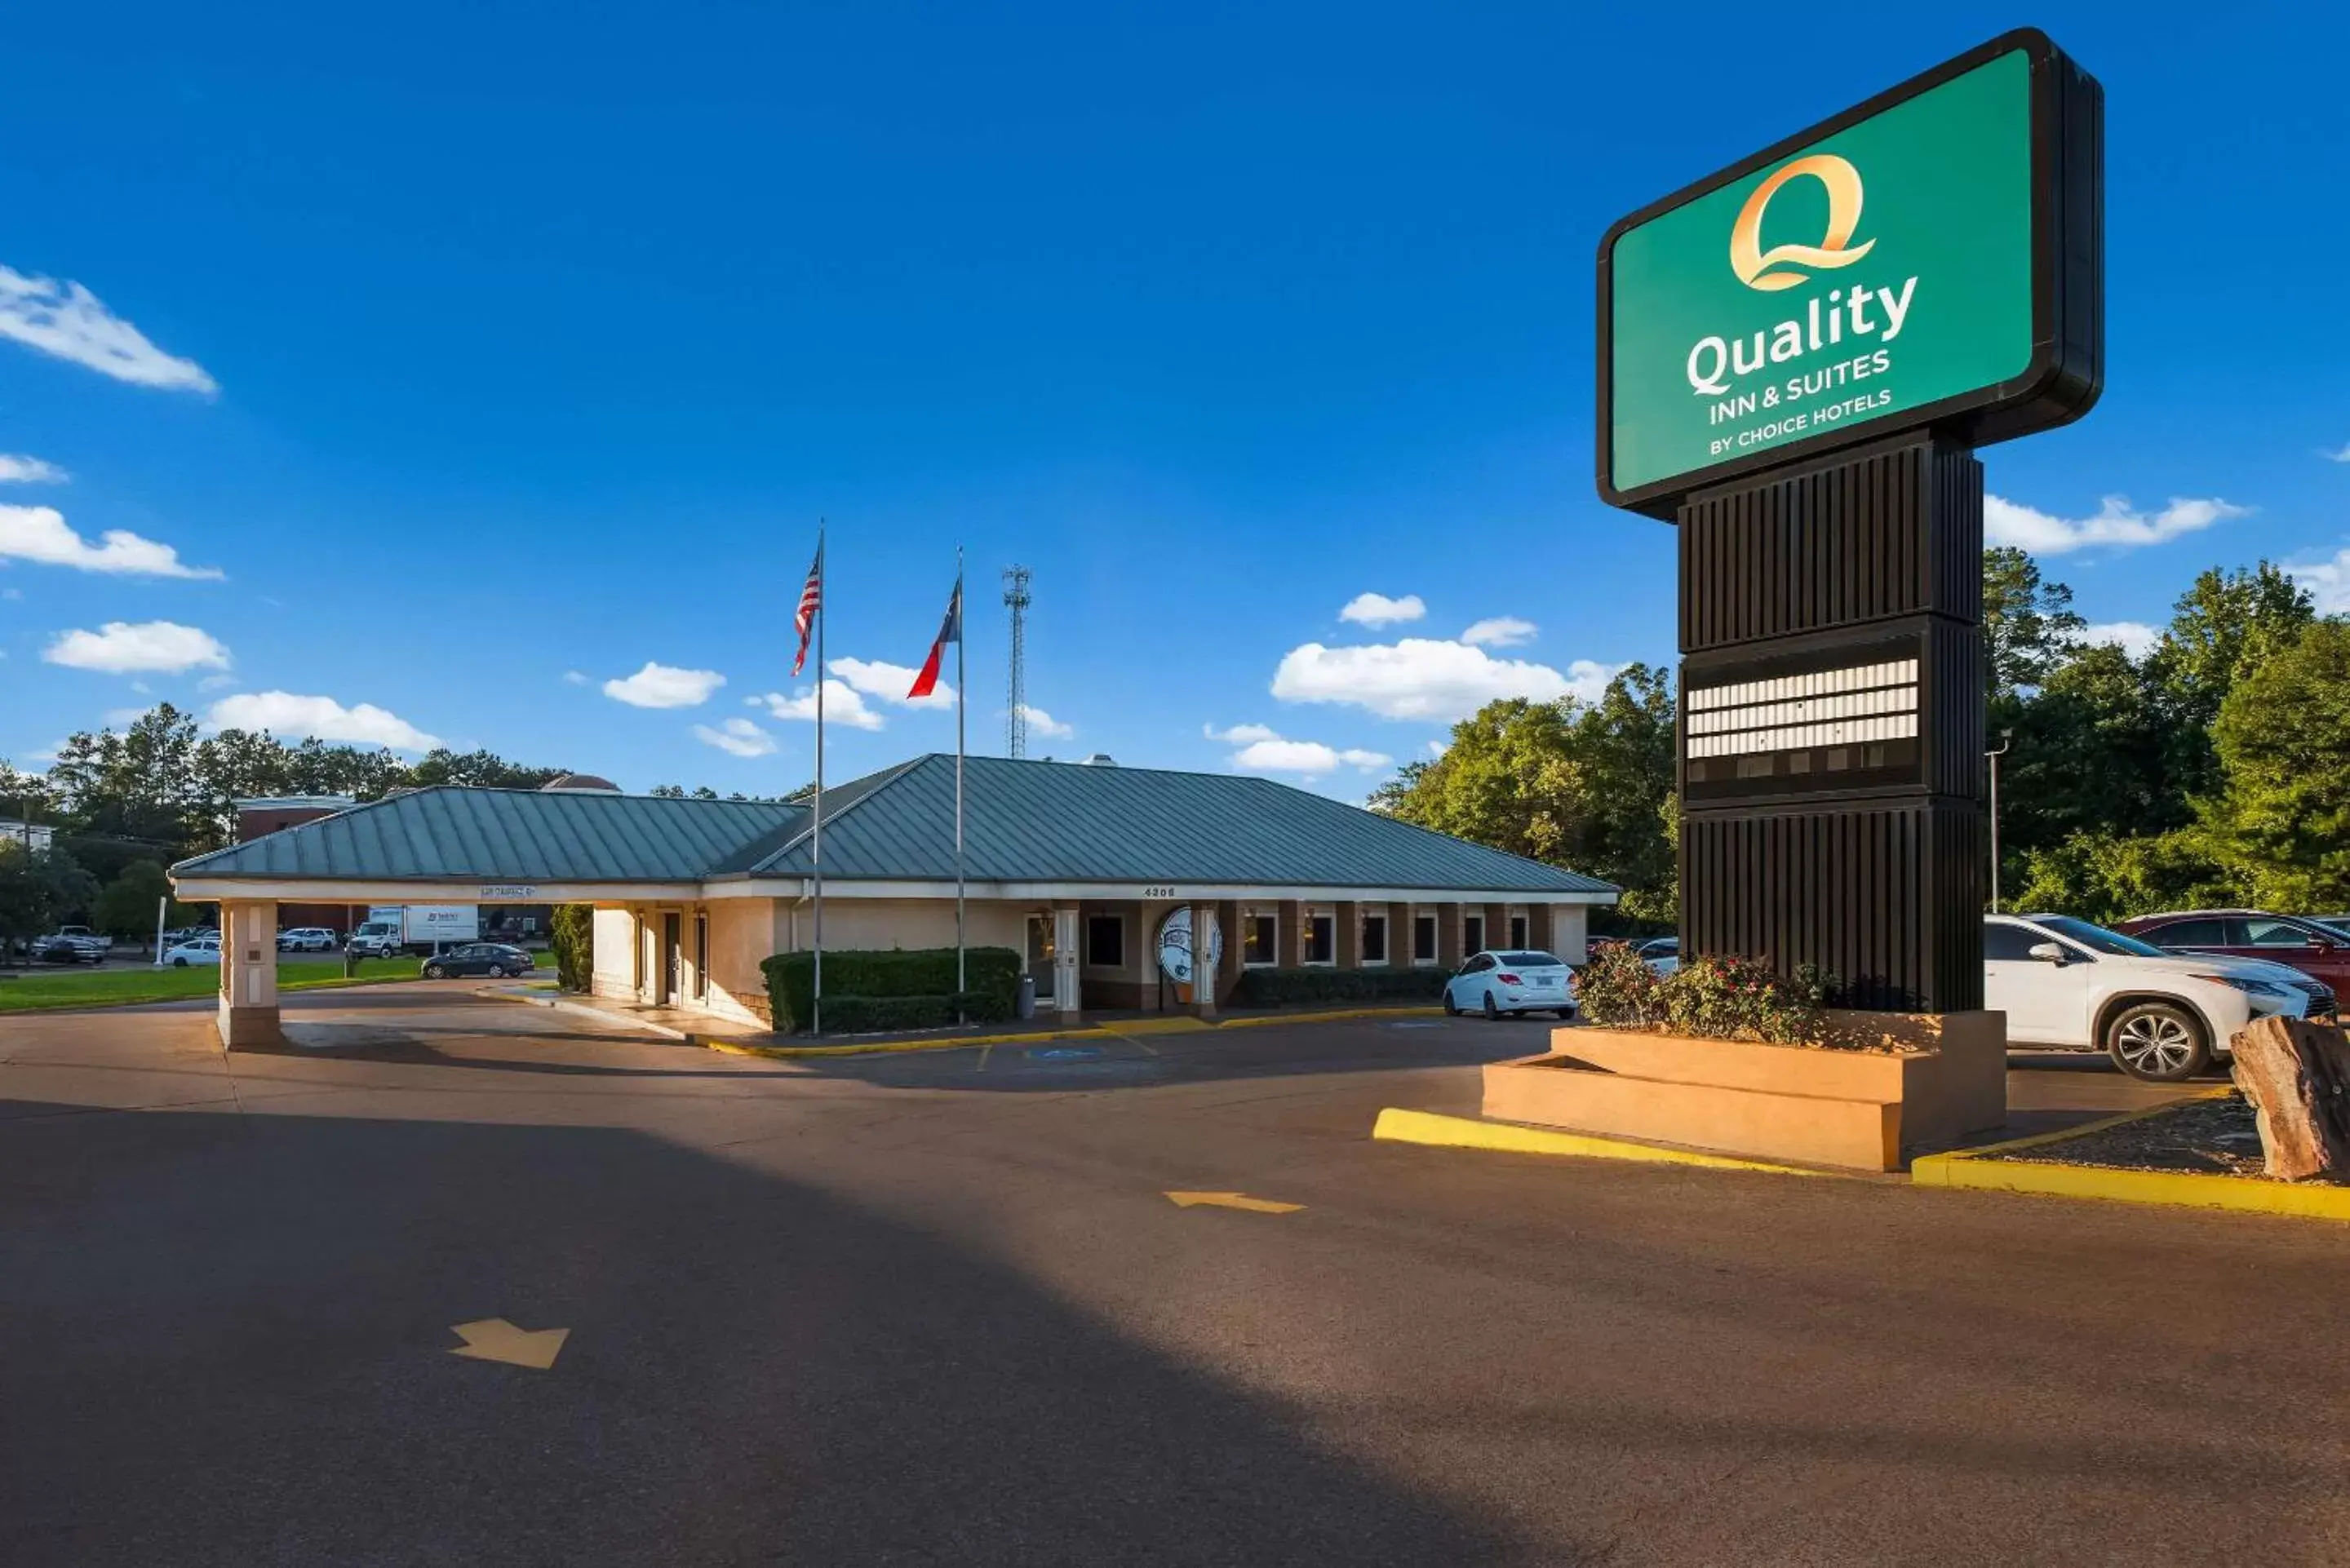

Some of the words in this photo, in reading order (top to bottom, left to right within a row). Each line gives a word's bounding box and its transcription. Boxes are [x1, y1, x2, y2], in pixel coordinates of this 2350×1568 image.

[1730, 154, 1876, 291] Q
[1687, 276, 1918, 396] Quality
[1709, 392, 1755, 425] INN
[1762, 386, 1780, 409] &
[1787, 348, 1891, 401] SUITES
[1710, 436, 1733, 455] BY
[1738, 414, 1808, 446] CHOICE
[1813, 389, 1891, 433] HOTELS
